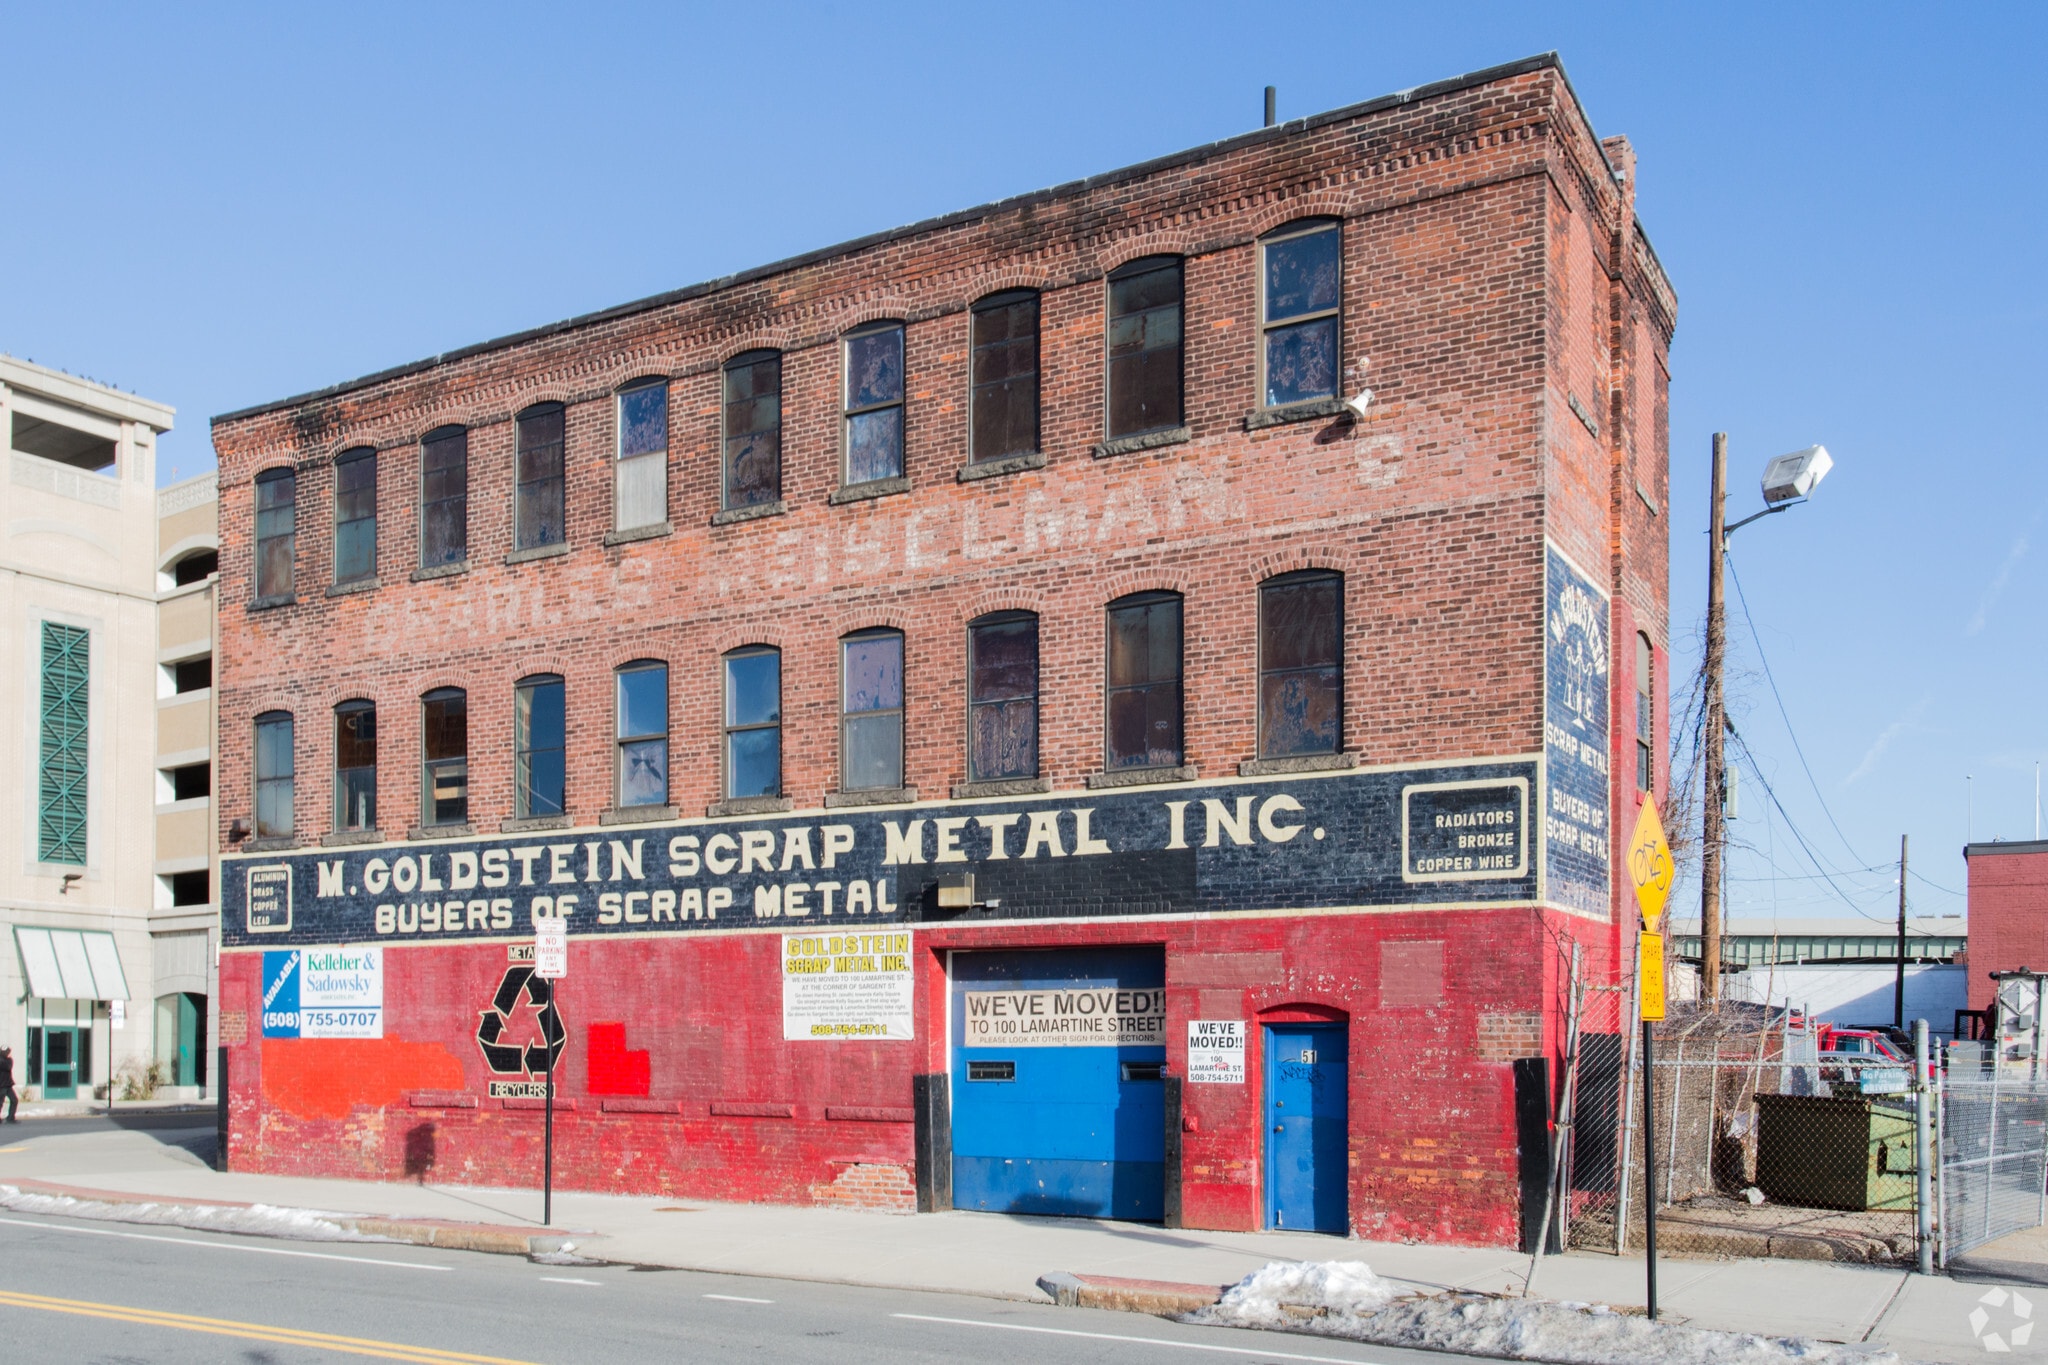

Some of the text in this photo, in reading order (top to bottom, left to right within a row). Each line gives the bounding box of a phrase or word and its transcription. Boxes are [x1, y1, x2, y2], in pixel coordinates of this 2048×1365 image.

[1546, 721, 1607, 775] SCRAP METAL
[1553, 788, 1604, 827] BUYERS OF
[1435, 811, 1514, 828] RADIATORS
[317, 794, 1325, 898] M. GOLDSTEIN SCRAP METAL INC.
[1458, 833, 1514, 848] BRONZE
[1546, 816, 1608, 861] SCRAP METAL
[1417, 855, 1514, 872] COPPER WIRE
[253, 872, 286, 883] ALUMINUM
[253, 887, 273, 897] BRASS
[253, 900, 278, 911] COPPER
[376, 879, 897, 934] BUYERS OF SCRAP METAL
[253, 916, 270, 926] LEAD
[546, 937, 556, 945] NO
[787, 934, 909, 956] GOLDSTEIN
[510, 946, 536, 960] META
[538, 947, 564, 955] PARKING
[1643, 944, 1660, 960] SHARE
[308, 952, 375, 971] Kelleher &
[786, 955, 910, 974] SCRAP METAL INC.
[263, 951, 299, 1010] AVAILABLE
[307, 973, 370, 996] Sadowsky
[1647, 970, 1657, 986] THE
[969, 994, 1044, 1016] WE'VE
[1645, 992, 1660, 1008] ROAD
[263, 1012, 377, 1029] (508) 755-0707
[971, 1016, 1165, 1034] TO 100 LAMARTINE STREET
[1198, 1023, 1235, 1034] WE'VE
[811, 1024, 887, 1036] 508-754-5711
[1107, 1034, 1155, 1042] DIRECTIONS
[1190, 1036, 1242, 1048] MOVED!!
[1302, 1050, 1315, 1063] 51
[1190, 1074, 1243, 1082] 508-754-5711
[1863, 1071, 1872, 1079] No
[495, 1082, 547, 1096] RECYCLERS
[1863, 1082, 1905, 1093] DRIVEWAY
